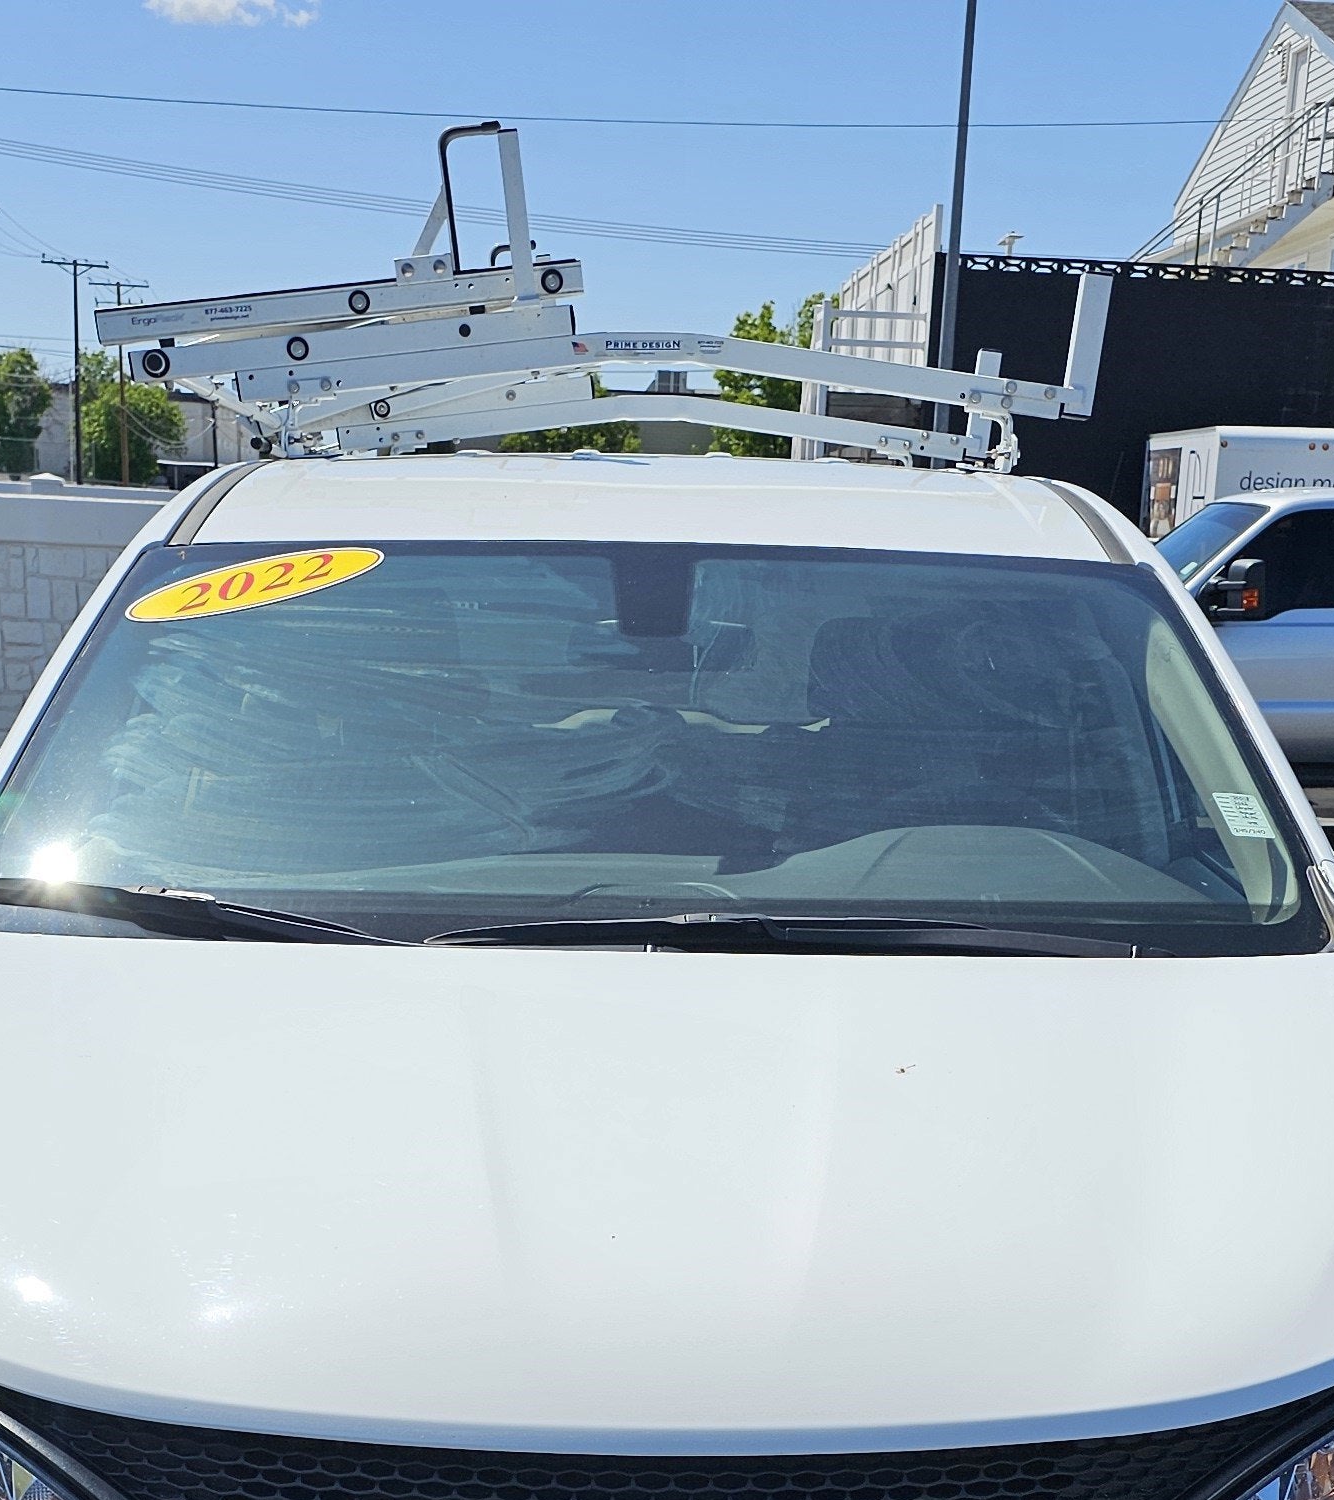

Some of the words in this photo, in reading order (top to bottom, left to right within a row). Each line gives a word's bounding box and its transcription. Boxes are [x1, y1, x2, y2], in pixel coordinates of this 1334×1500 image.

[605, 340, 638, 349] PRIME
[642, 340, 681, 349] DESIGN
[175, 553, 334, 614] 2022
